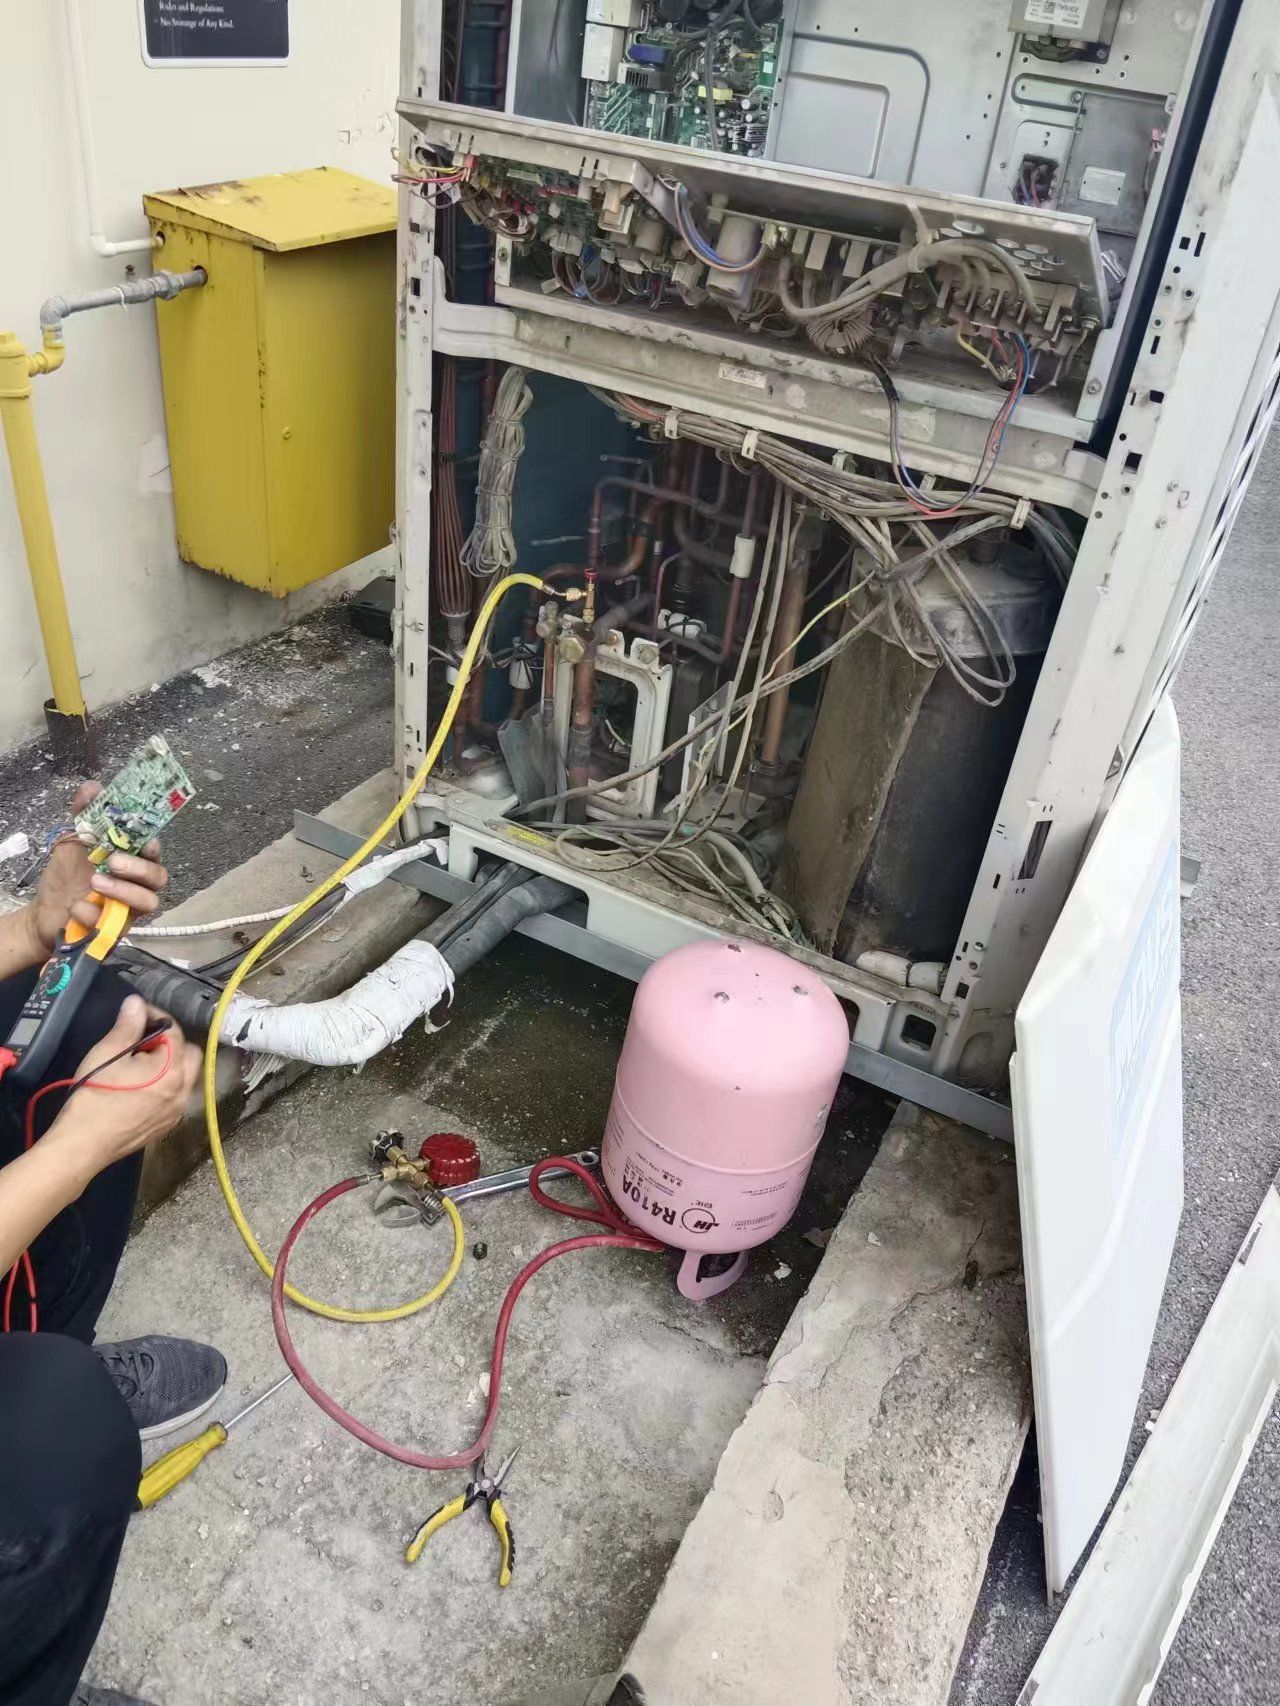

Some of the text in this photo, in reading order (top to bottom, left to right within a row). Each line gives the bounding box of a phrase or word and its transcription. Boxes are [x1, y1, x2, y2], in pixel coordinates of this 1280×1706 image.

[160, 1, 177, 11] Rules
[178, 3, 189, 11] and
[198, 18, 205, 27] of
[206, 18, 217, 29] Any
[622, 1174, 676, 1225] R410A
